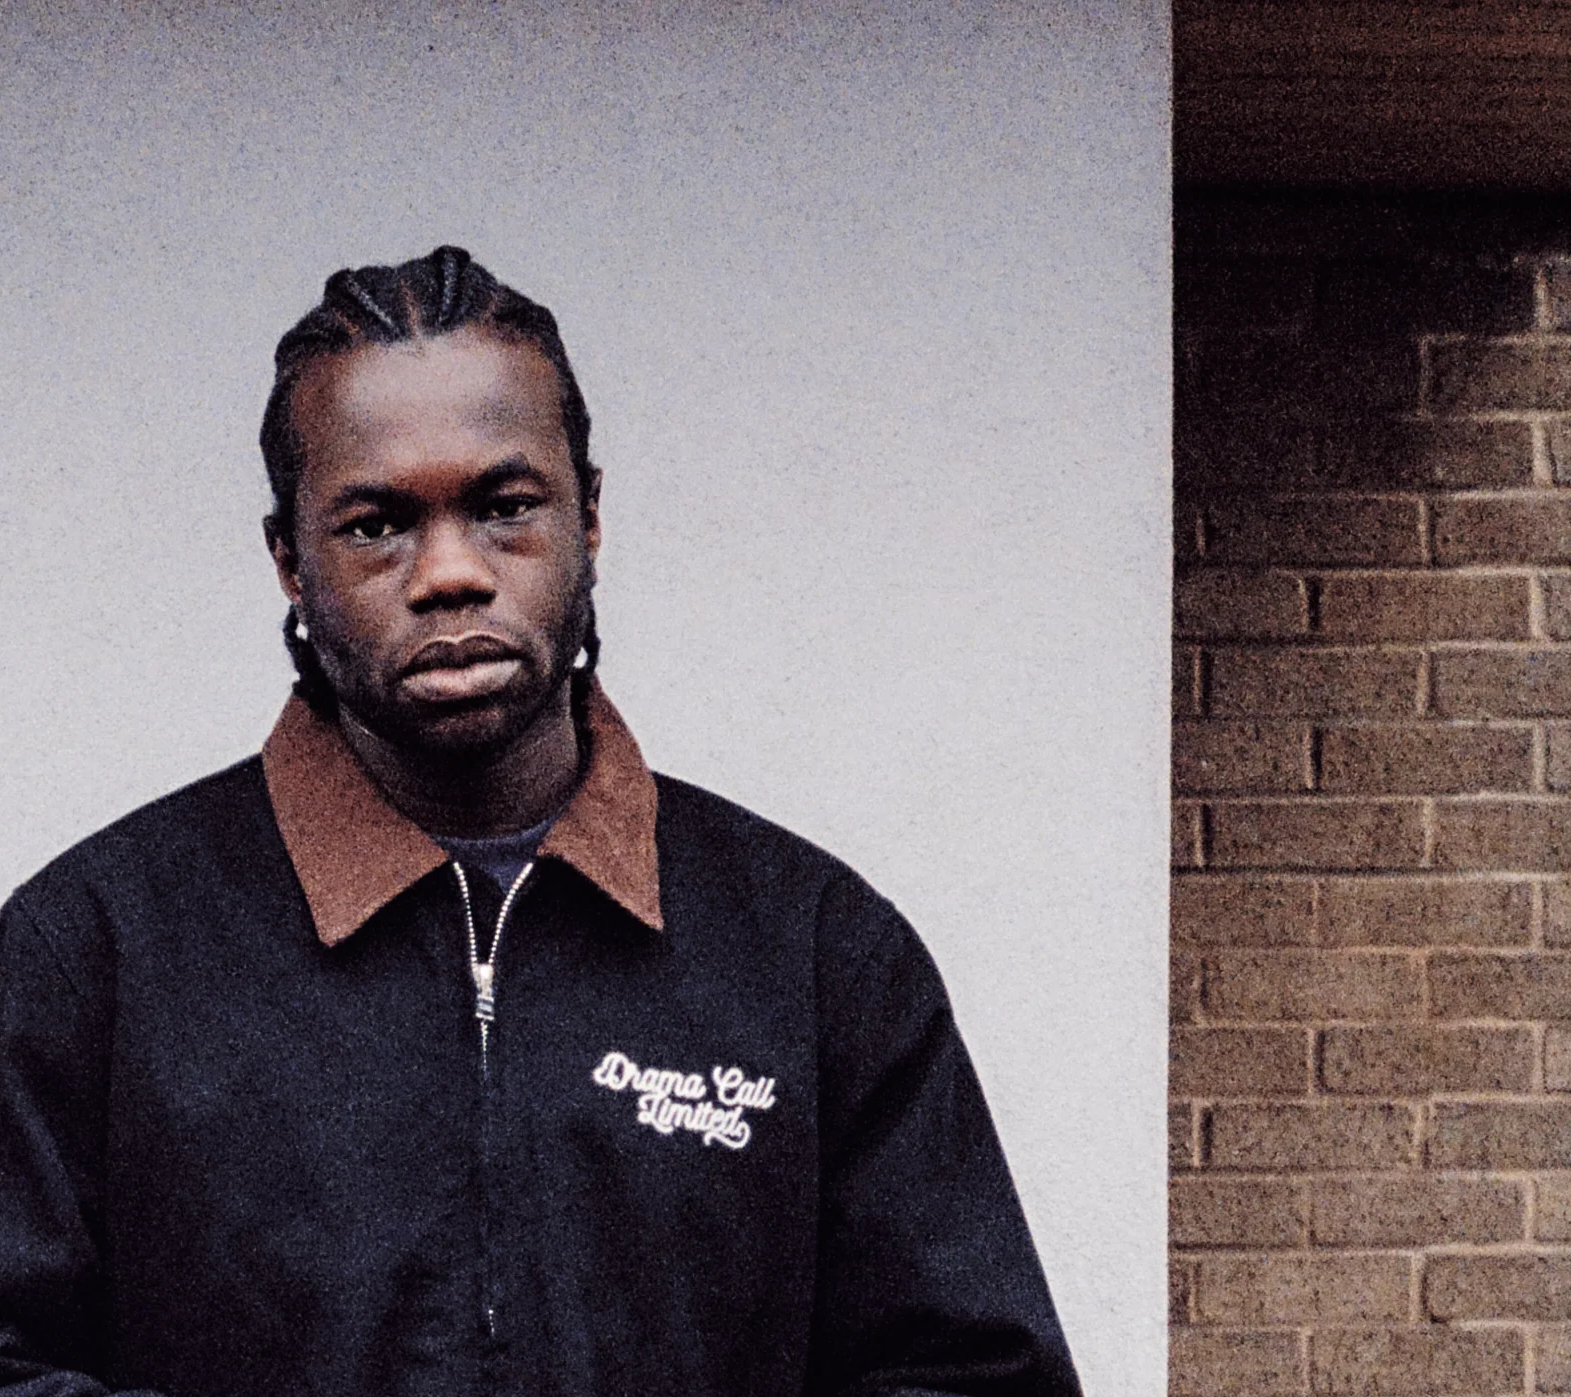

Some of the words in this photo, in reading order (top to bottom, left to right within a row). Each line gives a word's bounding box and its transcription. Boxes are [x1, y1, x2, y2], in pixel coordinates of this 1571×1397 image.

[593, 1051, 707, 1099] Drama
[712, 1065, 776, 1109] Call
[637, 1093, 751, 1149] Limited
